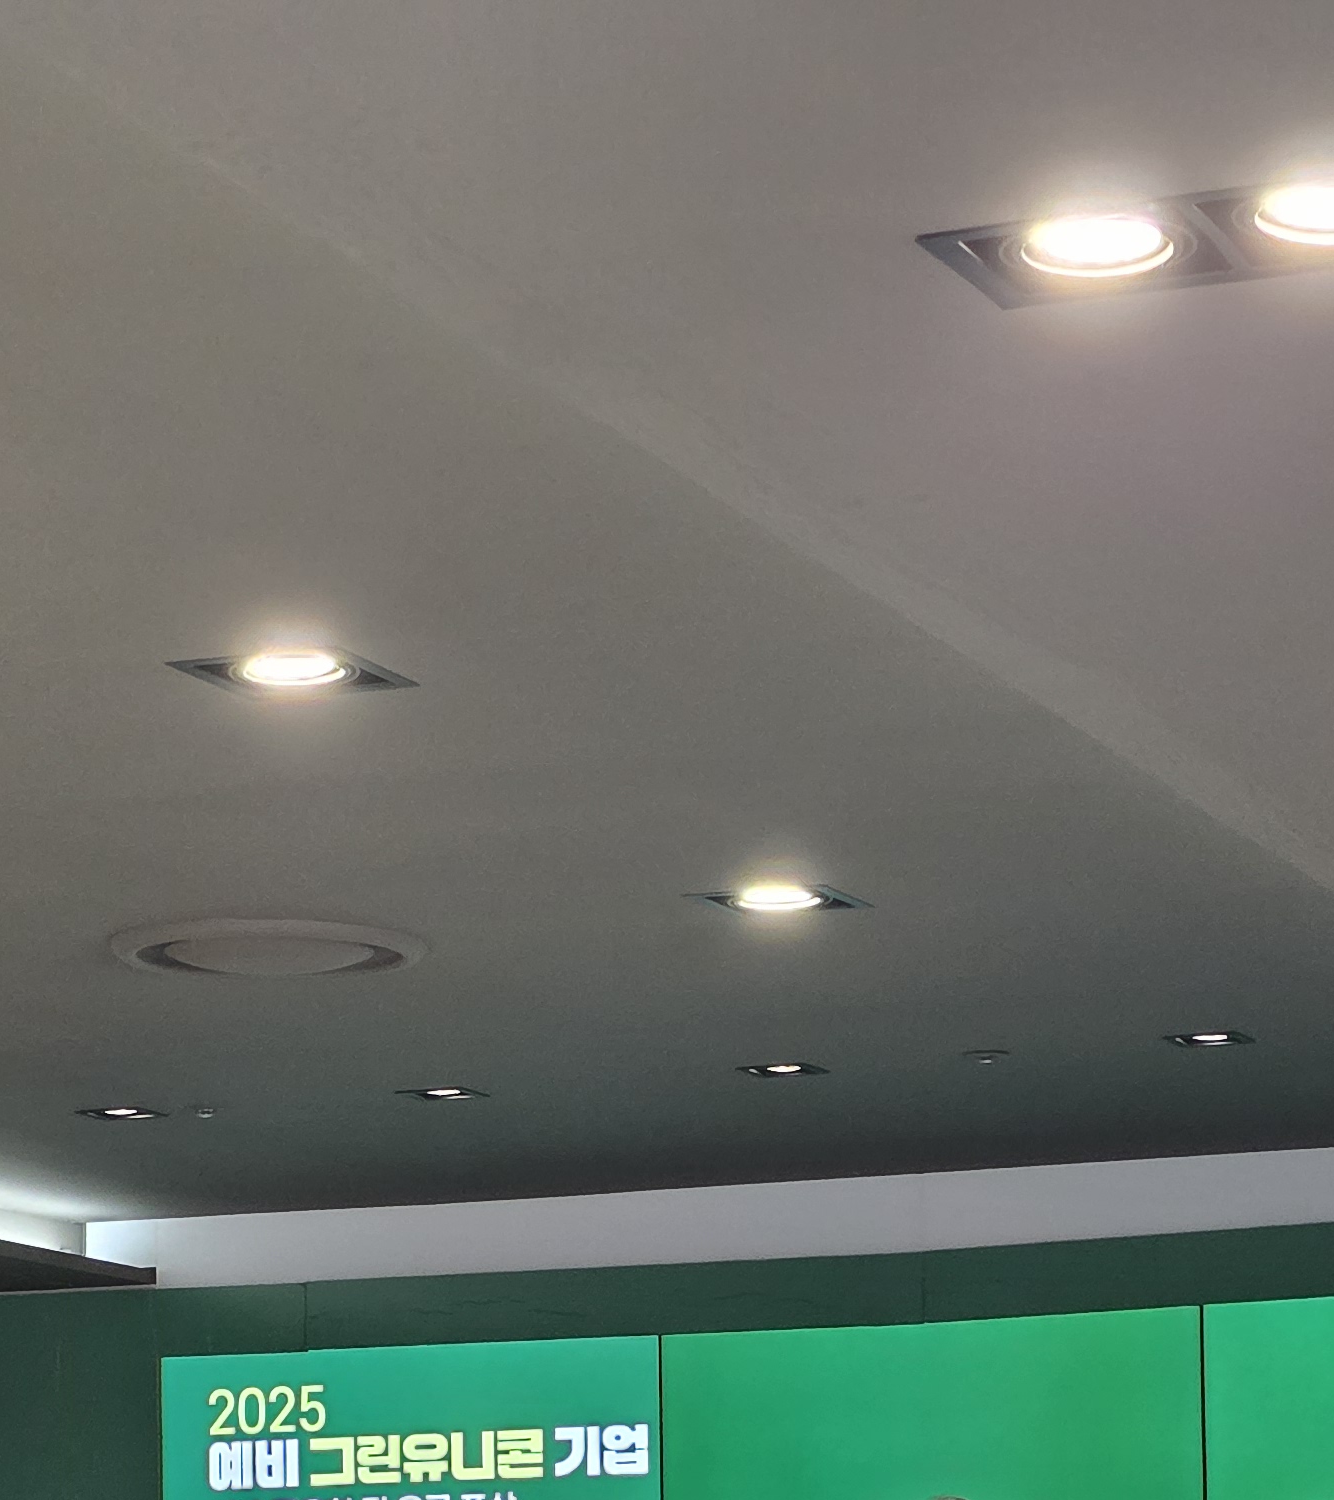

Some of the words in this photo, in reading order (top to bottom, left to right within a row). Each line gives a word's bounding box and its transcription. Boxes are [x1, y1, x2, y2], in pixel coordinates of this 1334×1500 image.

[208, 1384, 326, 1436] 2025
[208, 1438, 300, 1492] 예비
[308, 1427, 544, 1487] 그린유니콘
[554, 1423, 649, 1478] 기업
